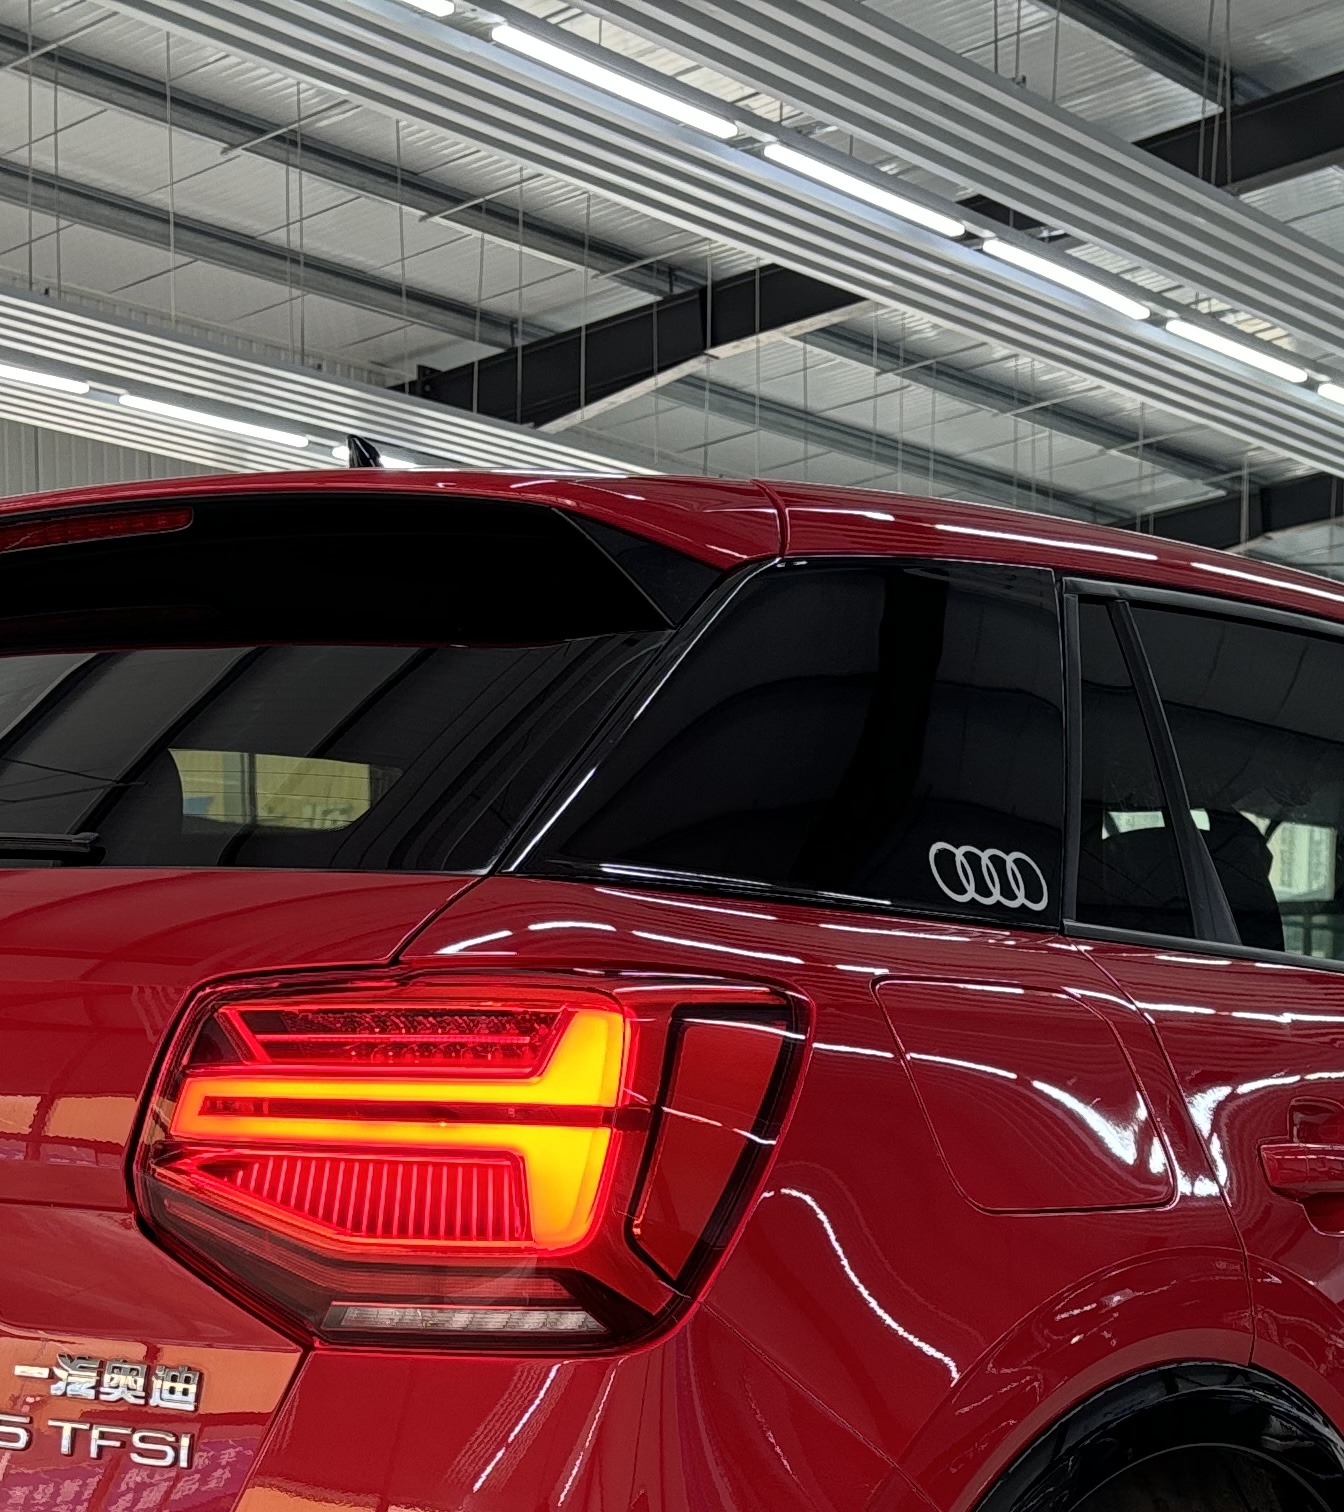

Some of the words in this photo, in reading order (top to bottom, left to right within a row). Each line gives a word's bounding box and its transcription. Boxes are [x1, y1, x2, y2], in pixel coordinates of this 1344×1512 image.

[13, 1352, 204, 1413] 一汽奥迪
[47, 1418, 196, 1470] TFSI
